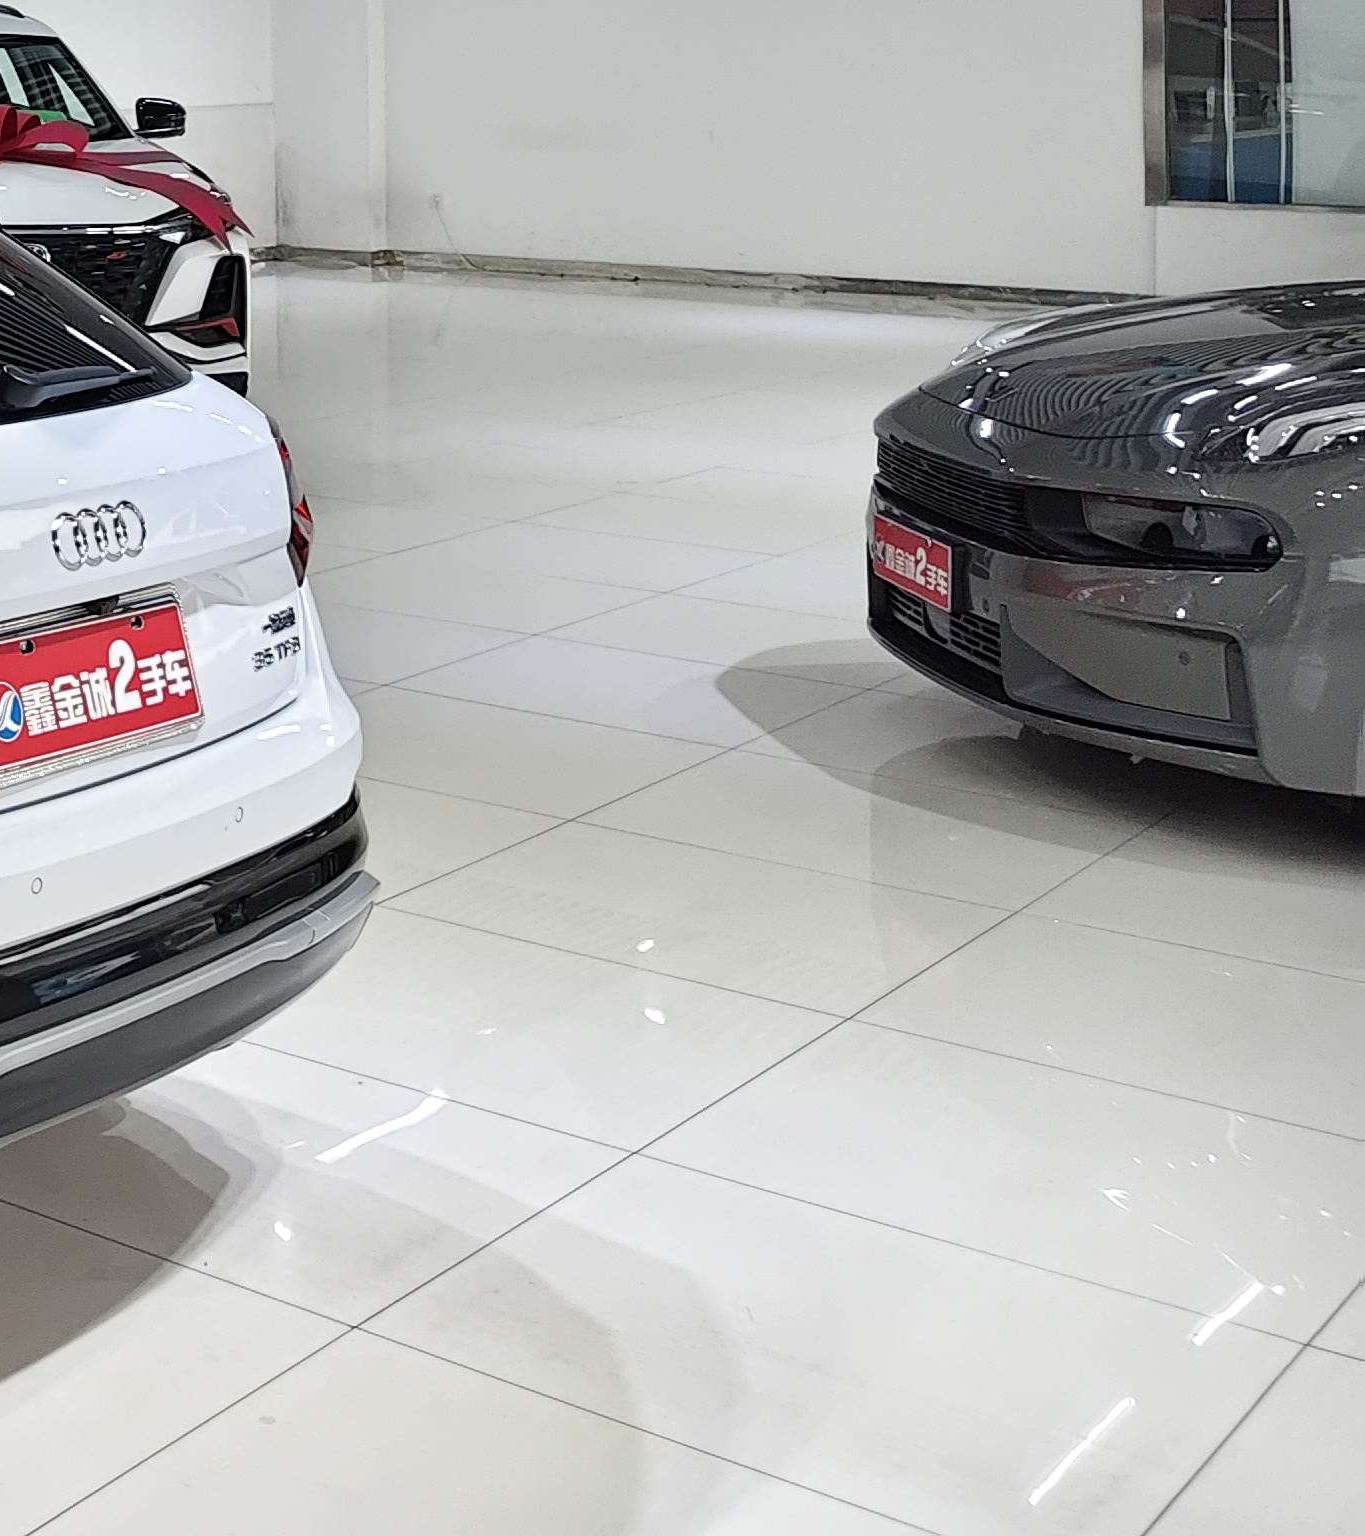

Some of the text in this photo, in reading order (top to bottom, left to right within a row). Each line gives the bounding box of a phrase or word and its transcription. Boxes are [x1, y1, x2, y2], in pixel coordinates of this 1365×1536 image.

[19, 639, 193, 737] 鑫金诚2手车
